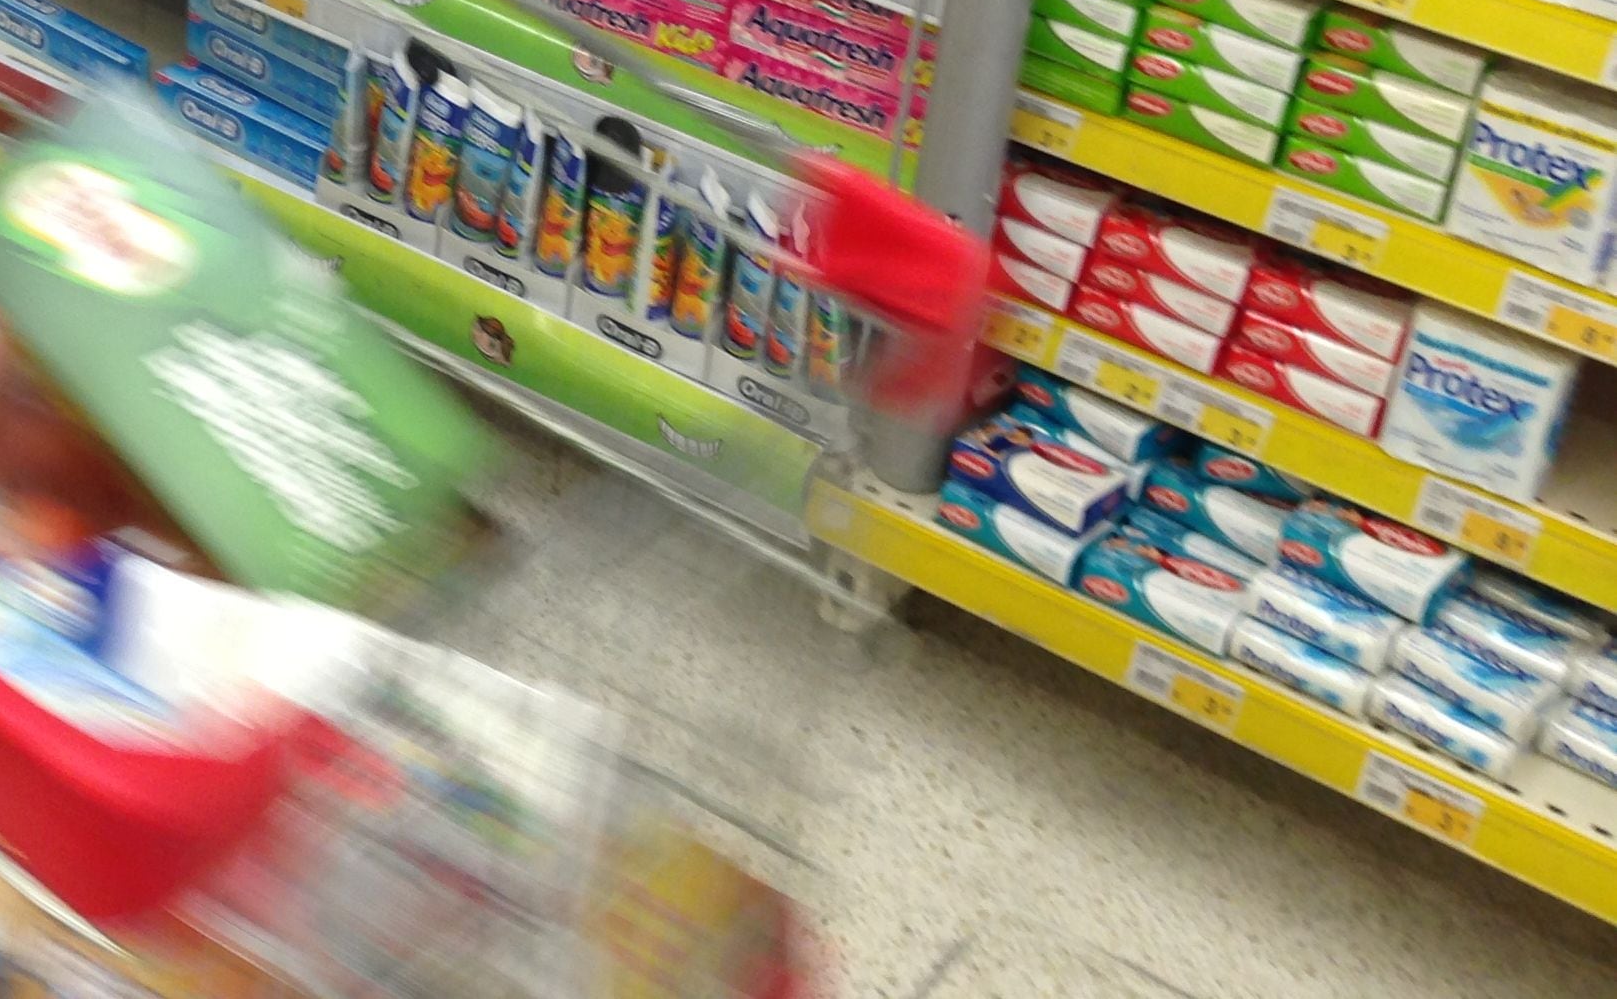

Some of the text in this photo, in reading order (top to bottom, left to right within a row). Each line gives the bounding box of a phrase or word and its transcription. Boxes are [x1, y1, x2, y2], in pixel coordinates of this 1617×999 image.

[210, 36, 265, 77] Oral-B
[747, 5, 895, 71] Aquafresh
[183, 100, 240, 139] Oral-B
[739, 63, 887, 130] Aquafresh
[1472, 121, 1590, 190] Protex
[1405, 349, 1532, 424] Protex
